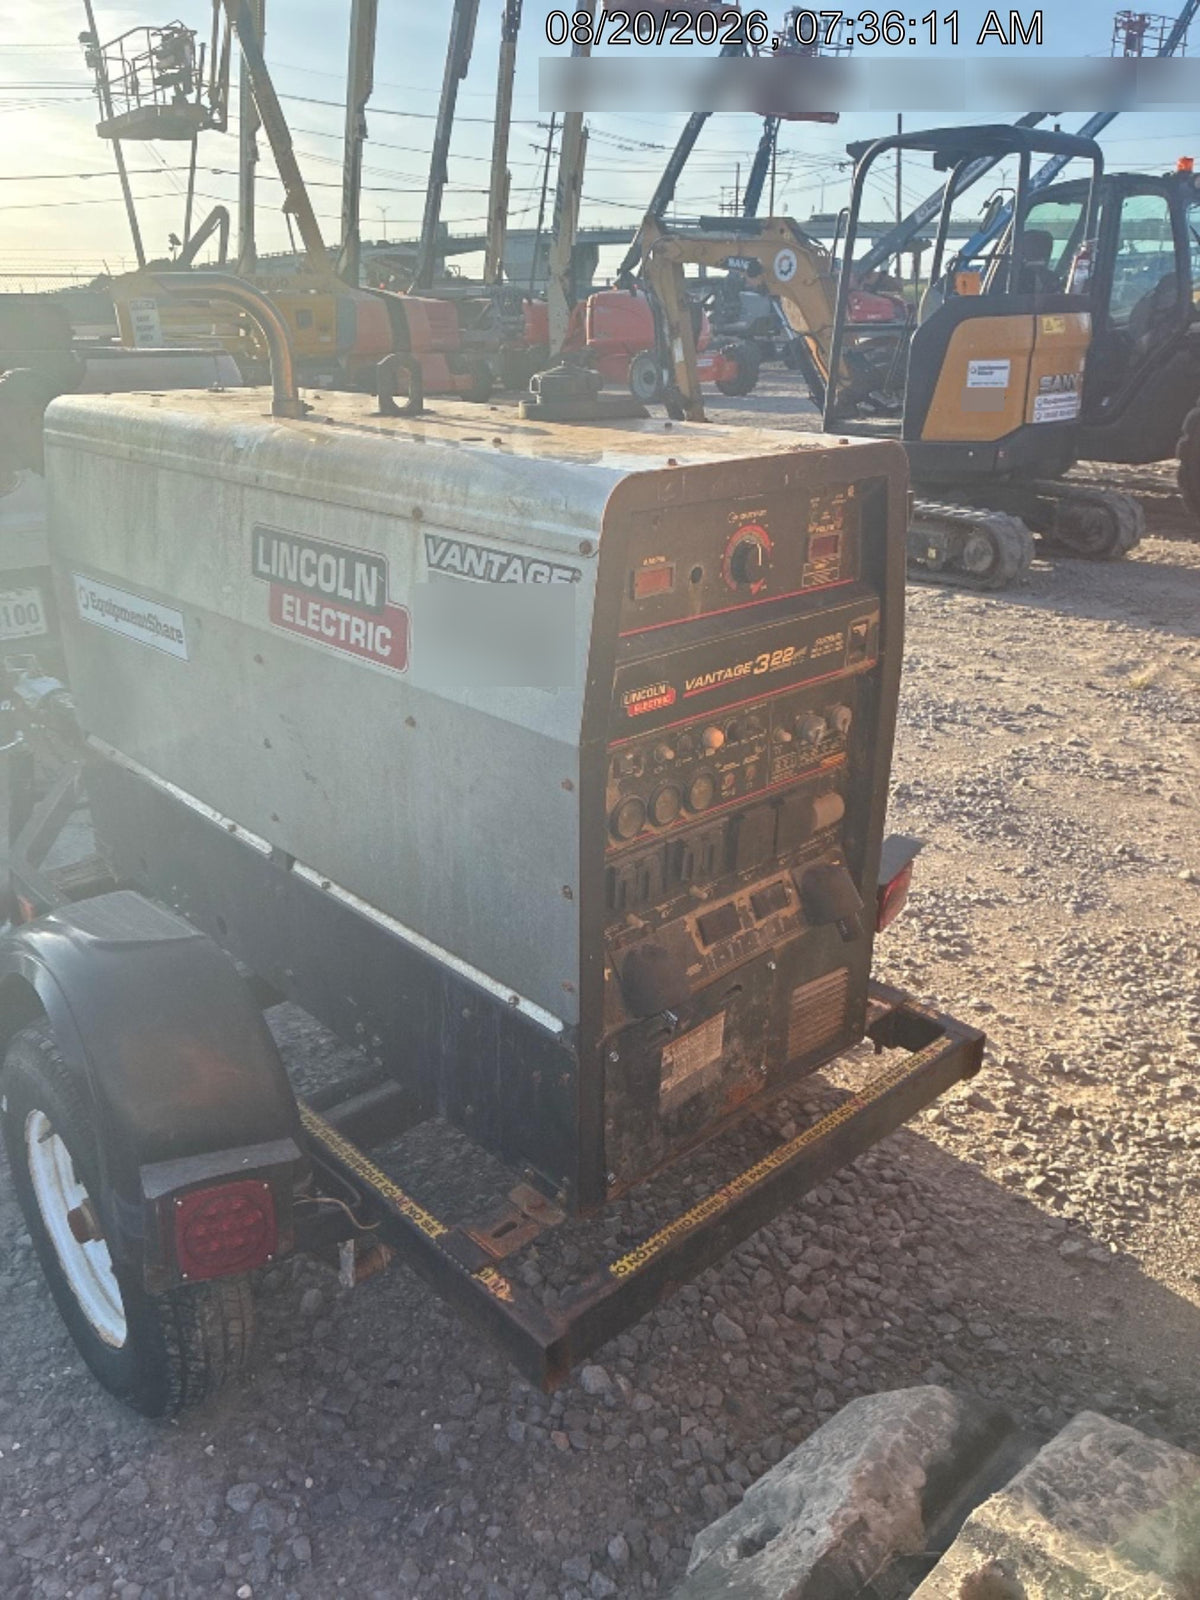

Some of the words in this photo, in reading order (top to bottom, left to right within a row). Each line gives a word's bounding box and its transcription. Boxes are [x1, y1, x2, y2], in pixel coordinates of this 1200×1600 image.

[257, 536, 379, 606] LINCOLN
[425, 536, 574, 584] VANTAGE
[2, 602, 40, 627] 100
[90, 590, 184, 644] EquipmentShare
[281, 594, 393, 657] ELECTRIC
[685, 661, 752, 691] VANTAGE
[753, 646, 796, 675] 322
[623, 683, 667, 705] LINCOLN
[404, 1204, 424, 1223] NO
